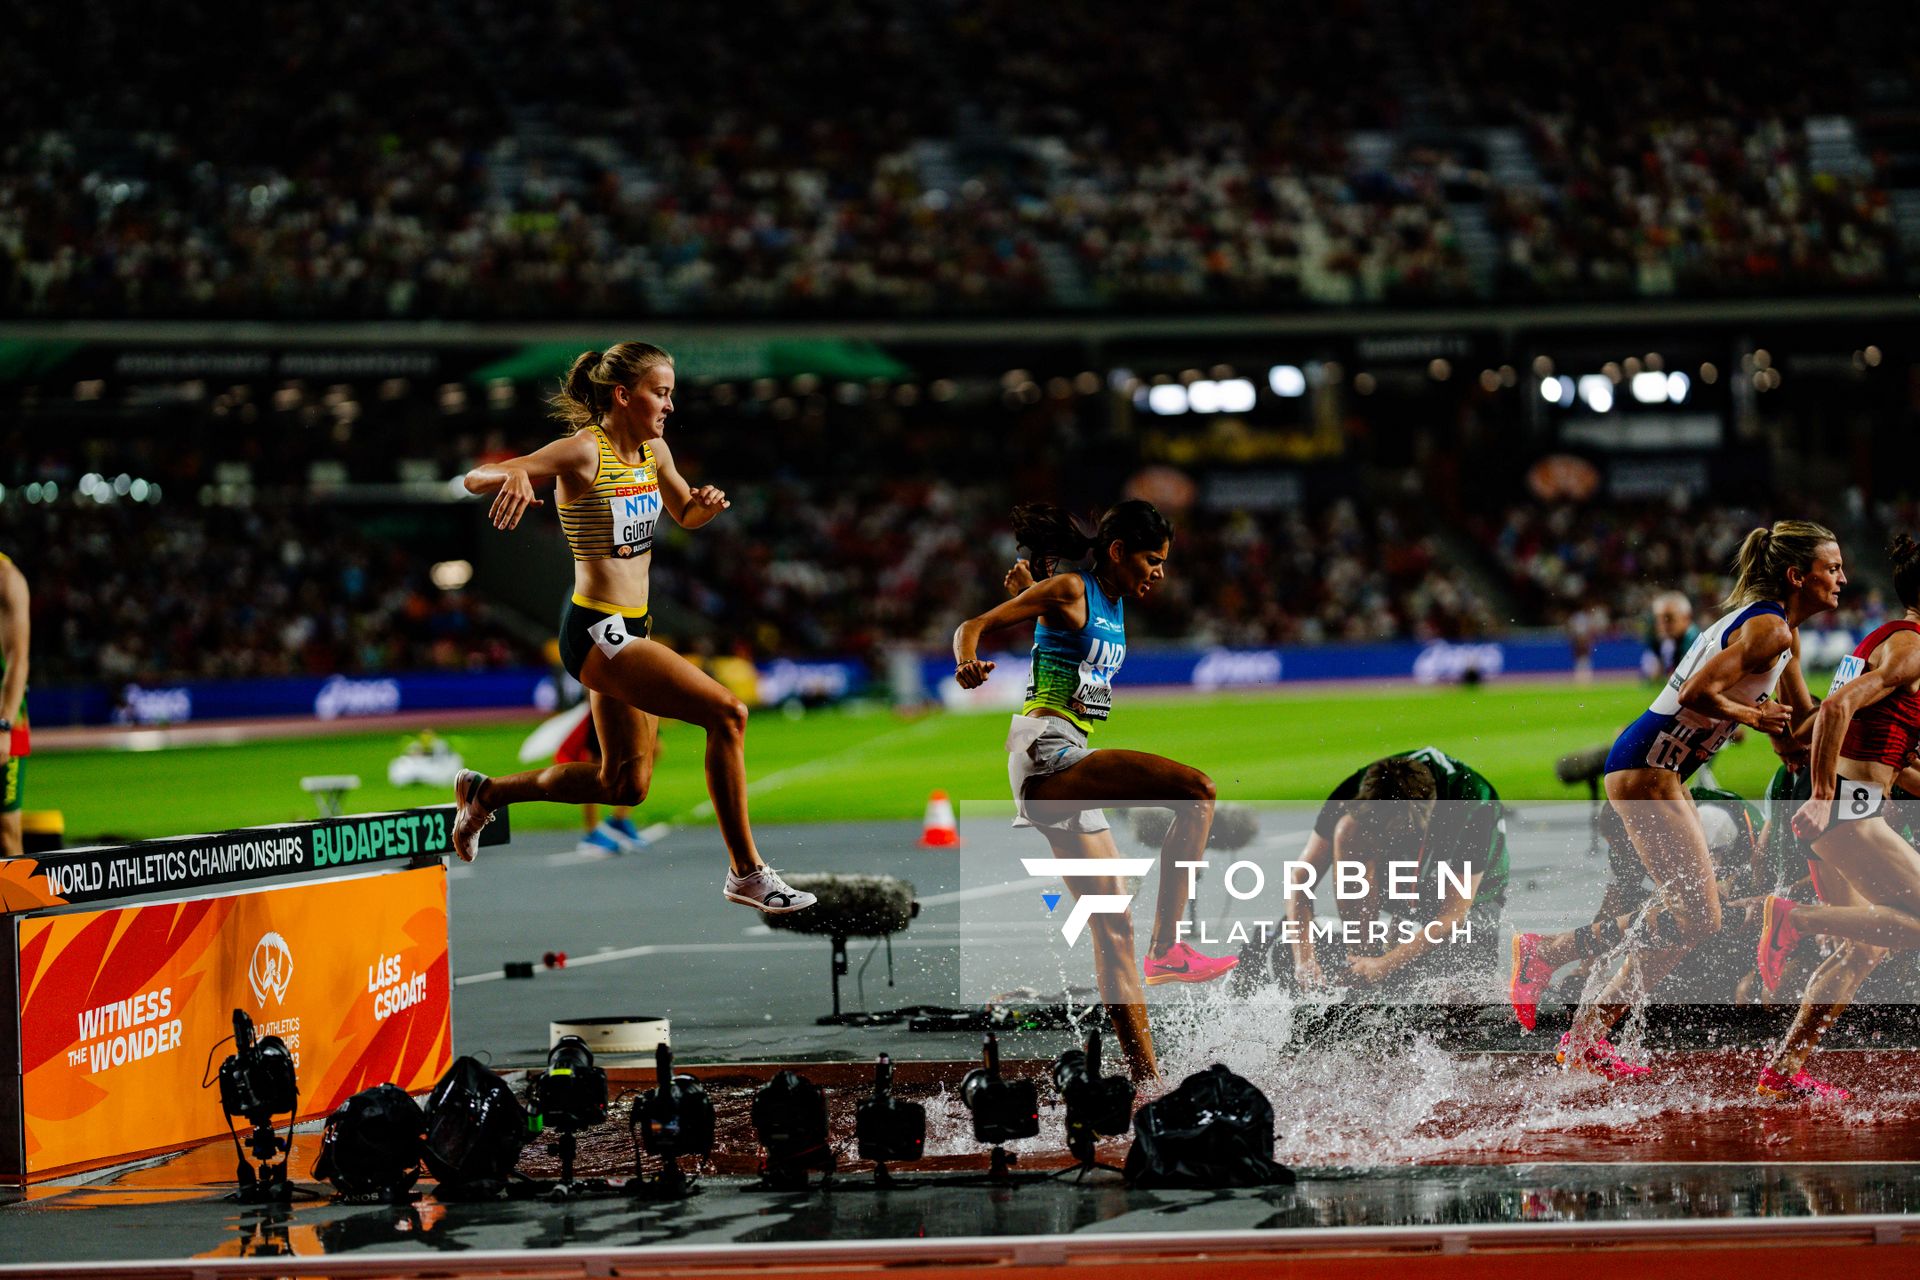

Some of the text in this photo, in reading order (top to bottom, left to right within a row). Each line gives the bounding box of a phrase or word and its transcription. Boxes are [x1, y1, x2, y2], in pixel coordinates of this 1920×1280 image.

[625, 491, 658, 518] NTN
[603, 623, 624, 646] 6
[1086, 637, 1124, 667] IND
[1655, 739, 1684, 769] 15
[1851, 787, 1869, 815] 8
[46, 813, 447, 896] WORLD ATHLETICS CHAMPIONSHIPS BUDAPEST 23
[368, 953, 401, 993] LÁSS
[374, 970, 427, 1021] CSODÁT!
[78, 987, 172, 1042] WITNESS
[265, 1017, 300, 1036] ATHLETICS
[68, 1019, 183, 1074] THE WONDER
